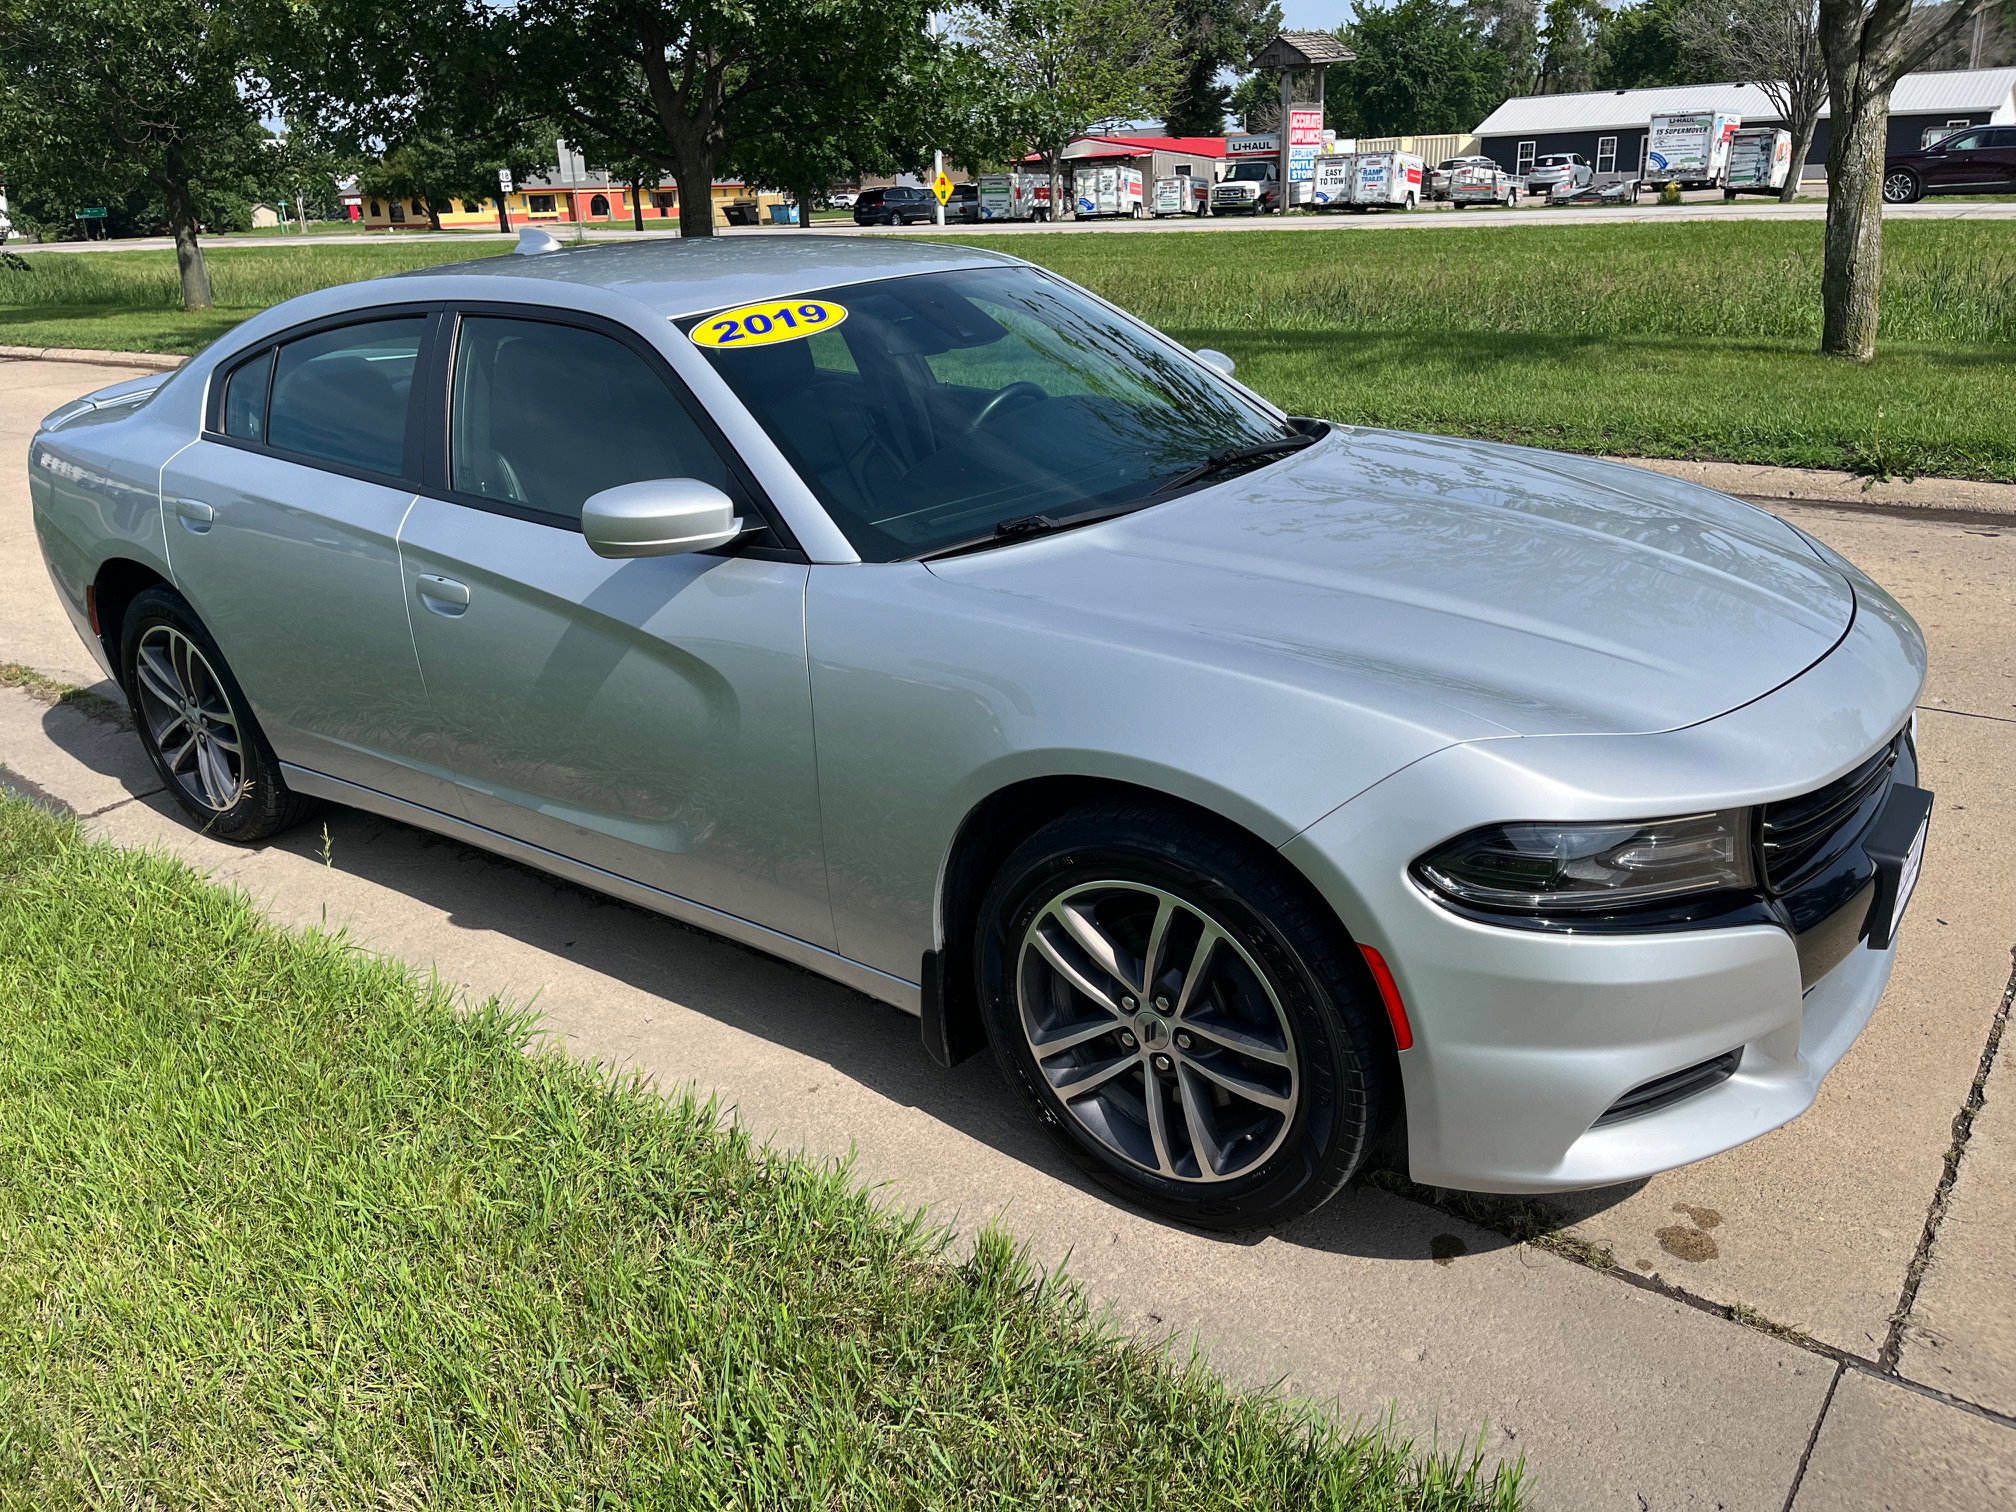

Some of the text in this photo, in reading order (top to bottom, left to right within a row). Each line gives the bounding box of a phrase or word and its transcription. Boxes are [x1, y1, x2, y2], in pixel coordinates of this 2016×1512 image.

[1292, 114, 1321, 128] ACCURATE
[1664, 127, 1708, 135] SUPERMOVER
[1291, 129, 1320, 143] APPLIANCE
[1232, 142, 1272, 151] U-HAUL
[1290, 160, 1315, 170] OUTLE
[501, 172, 510, 180] 18
[1292, 170, 1314, 179] STOR
[1325, 168, 1342, 177] EASY
[1320, 178, 1328, 186] TO
[713, 304, 828, 344] 2019
